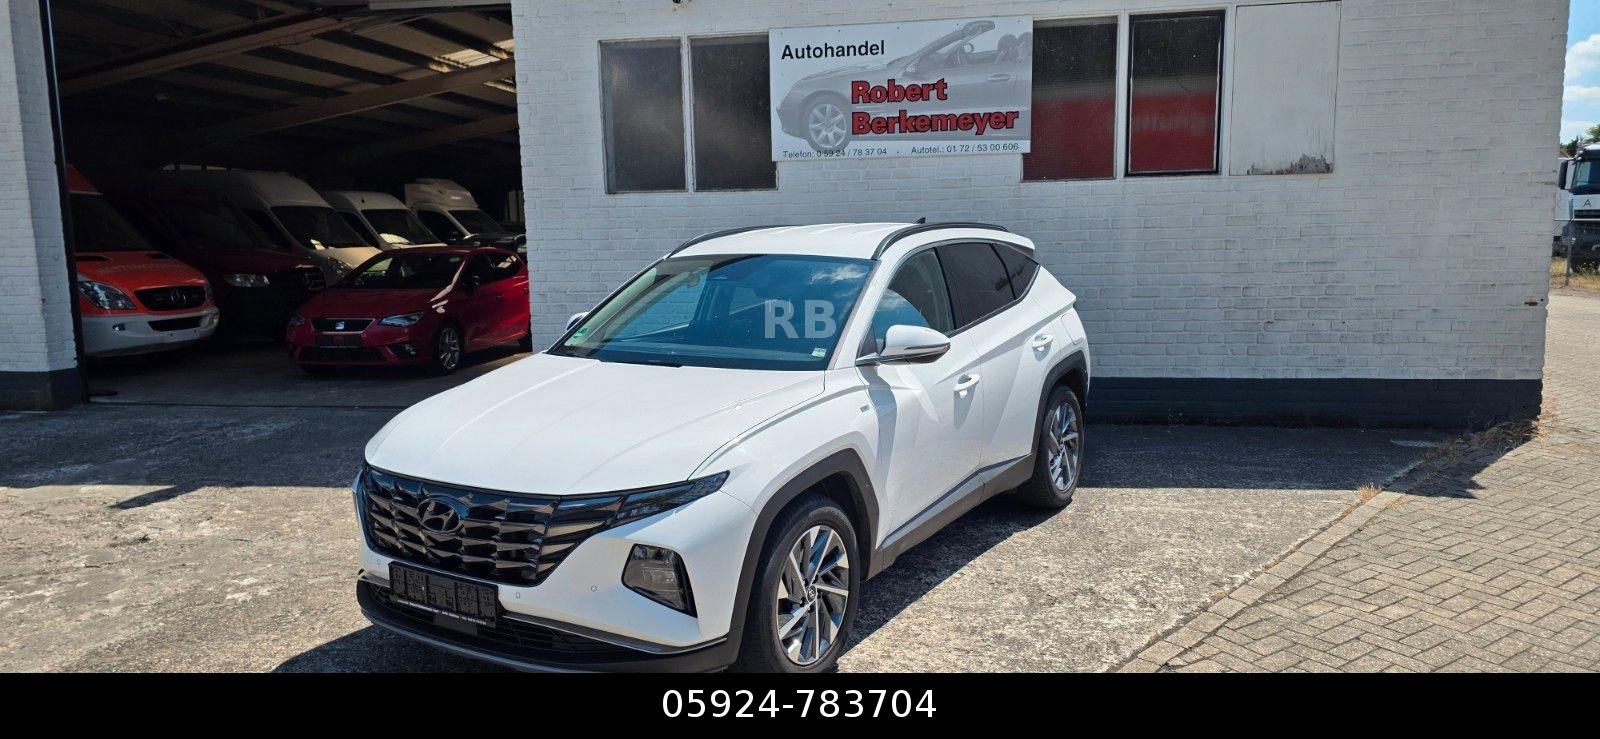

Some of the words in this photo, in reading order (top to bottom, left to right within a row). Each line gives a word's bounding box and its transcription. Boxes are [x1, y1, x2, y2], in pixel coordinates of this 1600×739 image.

[781, 40, 885, 60] Autohandel
[851, 78, 948, 104] Robert
[851, 110, 1020, 136] Berkemeyer
[783, 149, 814, 159] Telefon:
[852, 148, 863, 157] 78
[864, 148, 875, 156] 37
[876, 147, 888, 156] 04
[946, 145, 957, 153] 01
[959, 144, 970, 152] 72
[977, 143, 988, 152] 53
[989, 143, 1001, 152] 00
[1002, 142, 1020, 151] 606
